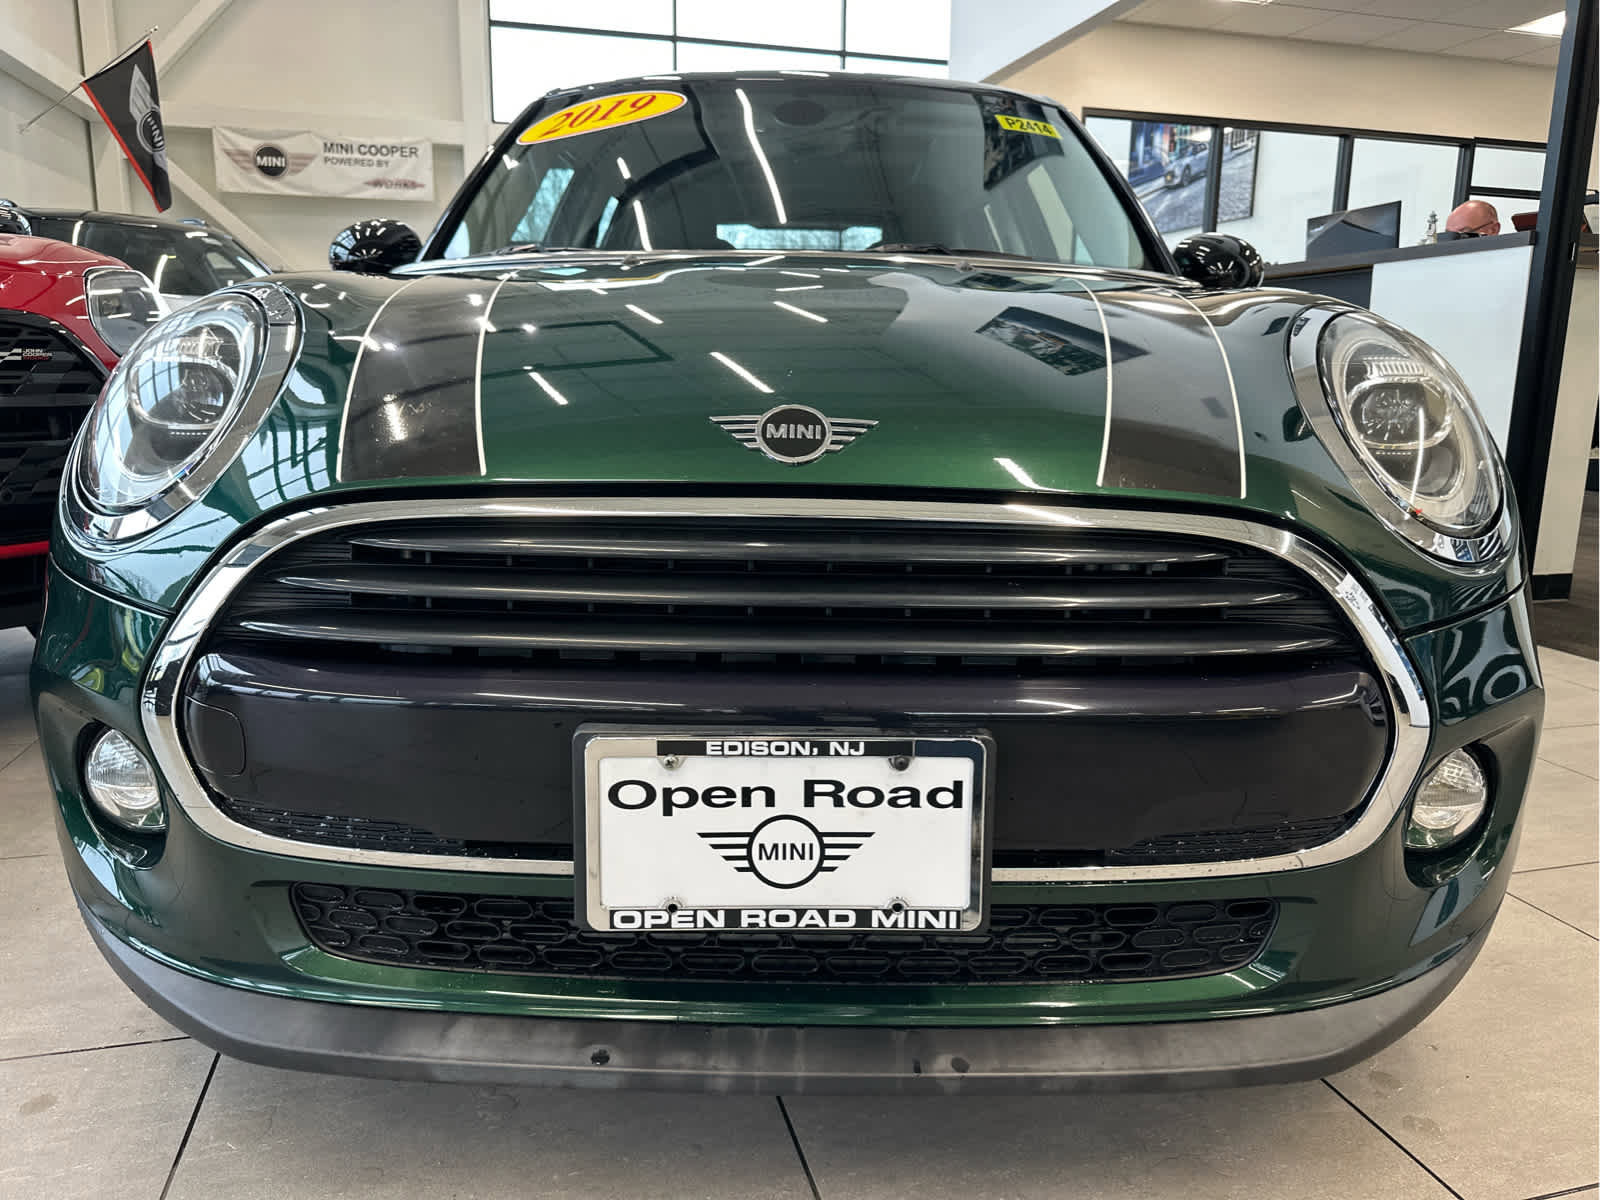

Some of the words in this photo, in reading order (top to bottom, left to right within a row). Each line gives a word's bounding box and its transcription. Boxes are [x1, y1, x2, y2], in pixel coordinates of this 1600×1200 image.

[537, 94, 657, 138] 2019
[1005, 117, 1052, 135] P2414
[323, 141, 354, 155] MINI
[357, 143, 419, 158] COOPER
[255, 154, 286, 169] MINI
[323, 156, 373, 168] POWERED
[376, 158, 390, 168] BY
[766, 423, 822, 440] MINI
[706, 741, 819, 757] EDISON,
[829, 741, 866, 756] NJ
[607, 779, 776, 816] Open
[803, 780, 964, 809] Road
[758, 842, 815, 861] MINI
[613, 909, 725, 930] OPEN
[740, 909, 856, 929] ROAD
[872, 909, 959, 929] MINI
